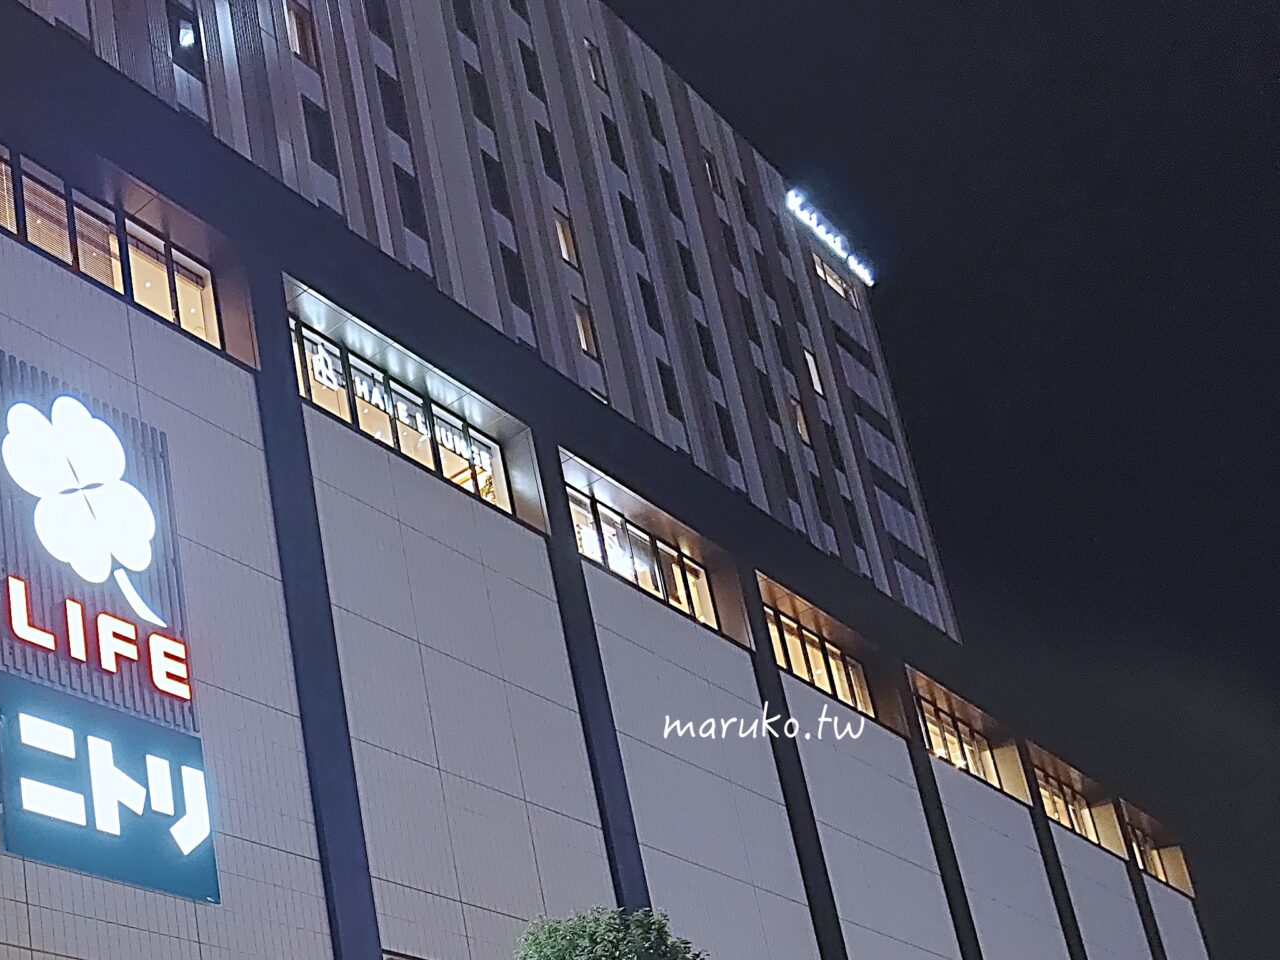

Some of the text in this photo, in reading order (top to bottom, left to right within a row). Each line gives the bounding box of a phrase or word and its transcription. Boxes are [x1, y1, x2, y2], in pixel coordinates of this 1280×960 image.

[7, 575, 192, 702] LIFE
[19, 711, 211, 857] ニトリ
